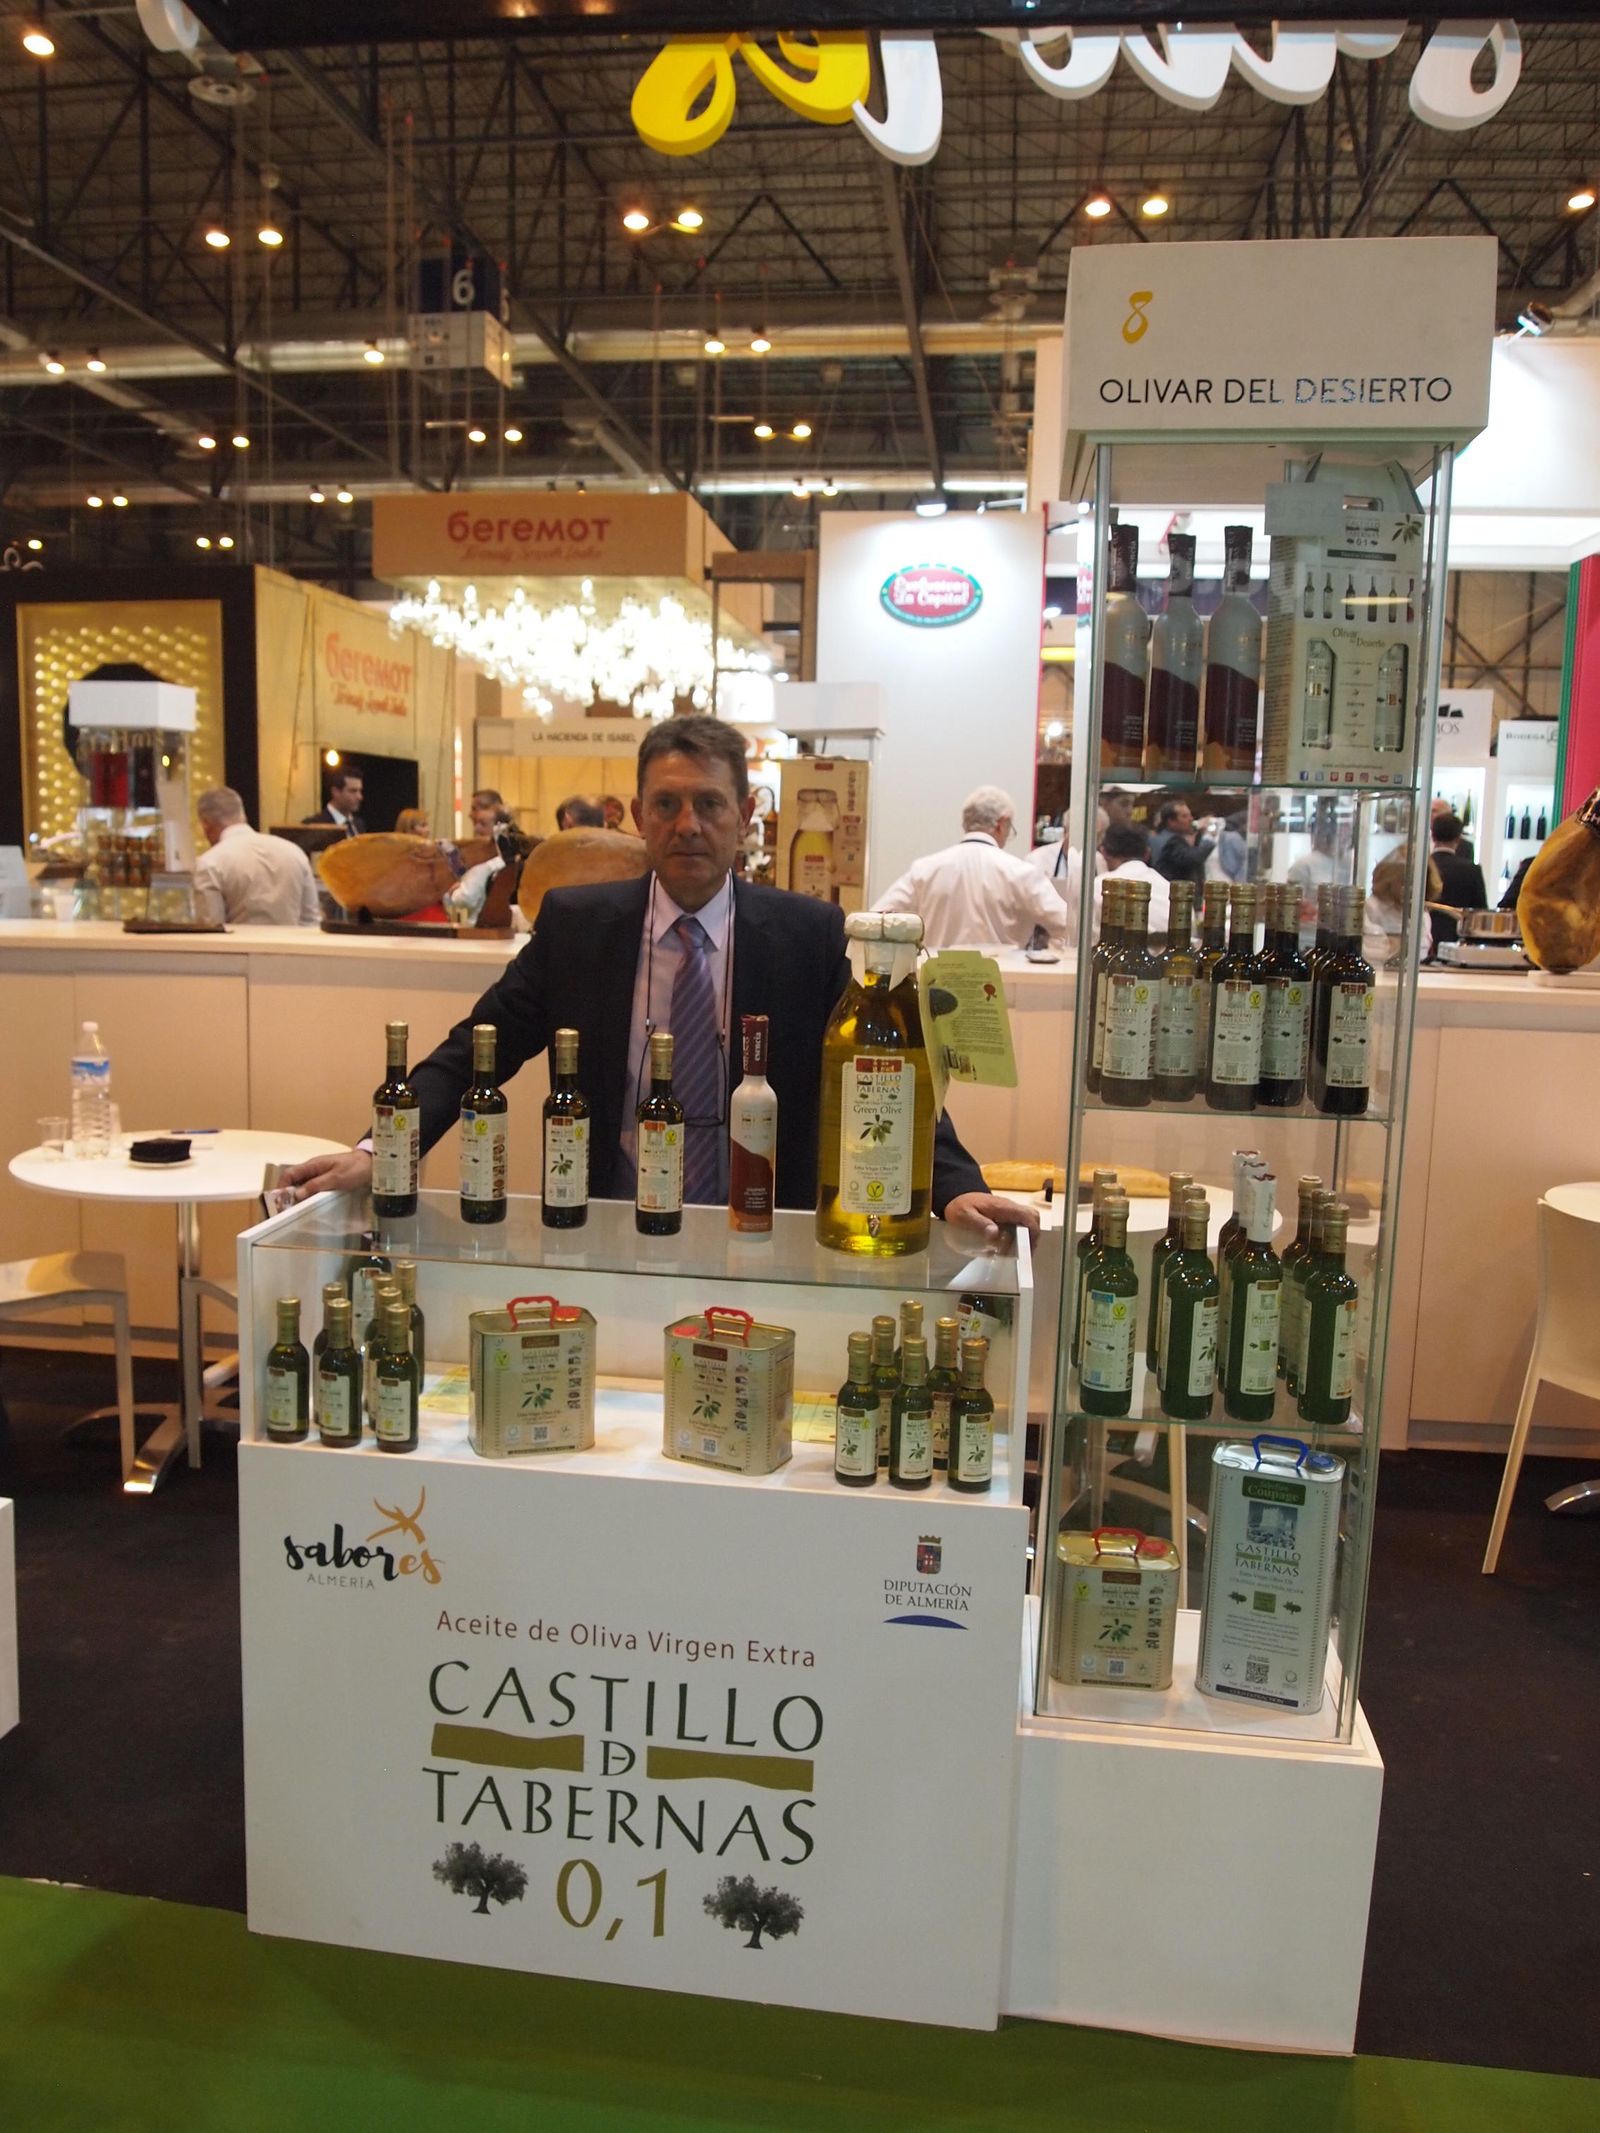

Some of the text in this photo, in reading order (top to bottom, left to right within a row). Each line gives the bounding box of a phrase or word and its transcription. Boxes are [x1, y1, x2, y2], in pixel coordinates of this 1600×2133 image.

[453, 268, 475, 305] 6
[1100, 377, 1452, 404] OLIVAR DEL DESIERTO
[447, 510, 611, 543] бегемот
[532, 732, 543, 742] LA
[592, 732, 603, 742] DE
[856, 1086, 901, 1094] TABERNAS
[853, 1104, 902, 1115] Green Olive
[1248, 1484, 1300, 1502] Coupage
[284, 1523, 446, 1585] sabores
[1235, 1543, 1301, 1562] CASTILLO
[1235, 1558, 1299, 1578] TABERNAS
[307, 1573, 375, 1590] ALMERÍA
[884, 1579, 972, 1597] DIPUTACIÓN
[885, 1594, 969, 1611] DE ALMERÍA
[436, 1610, 816, 1667] Aceite de Oliva Virgen Extra
[428, 1660, 823, 1752] CASTILLO
[422, 1767, 817, 1866] TABERNAS
[556, 1858, 669, 1942] 0,1
